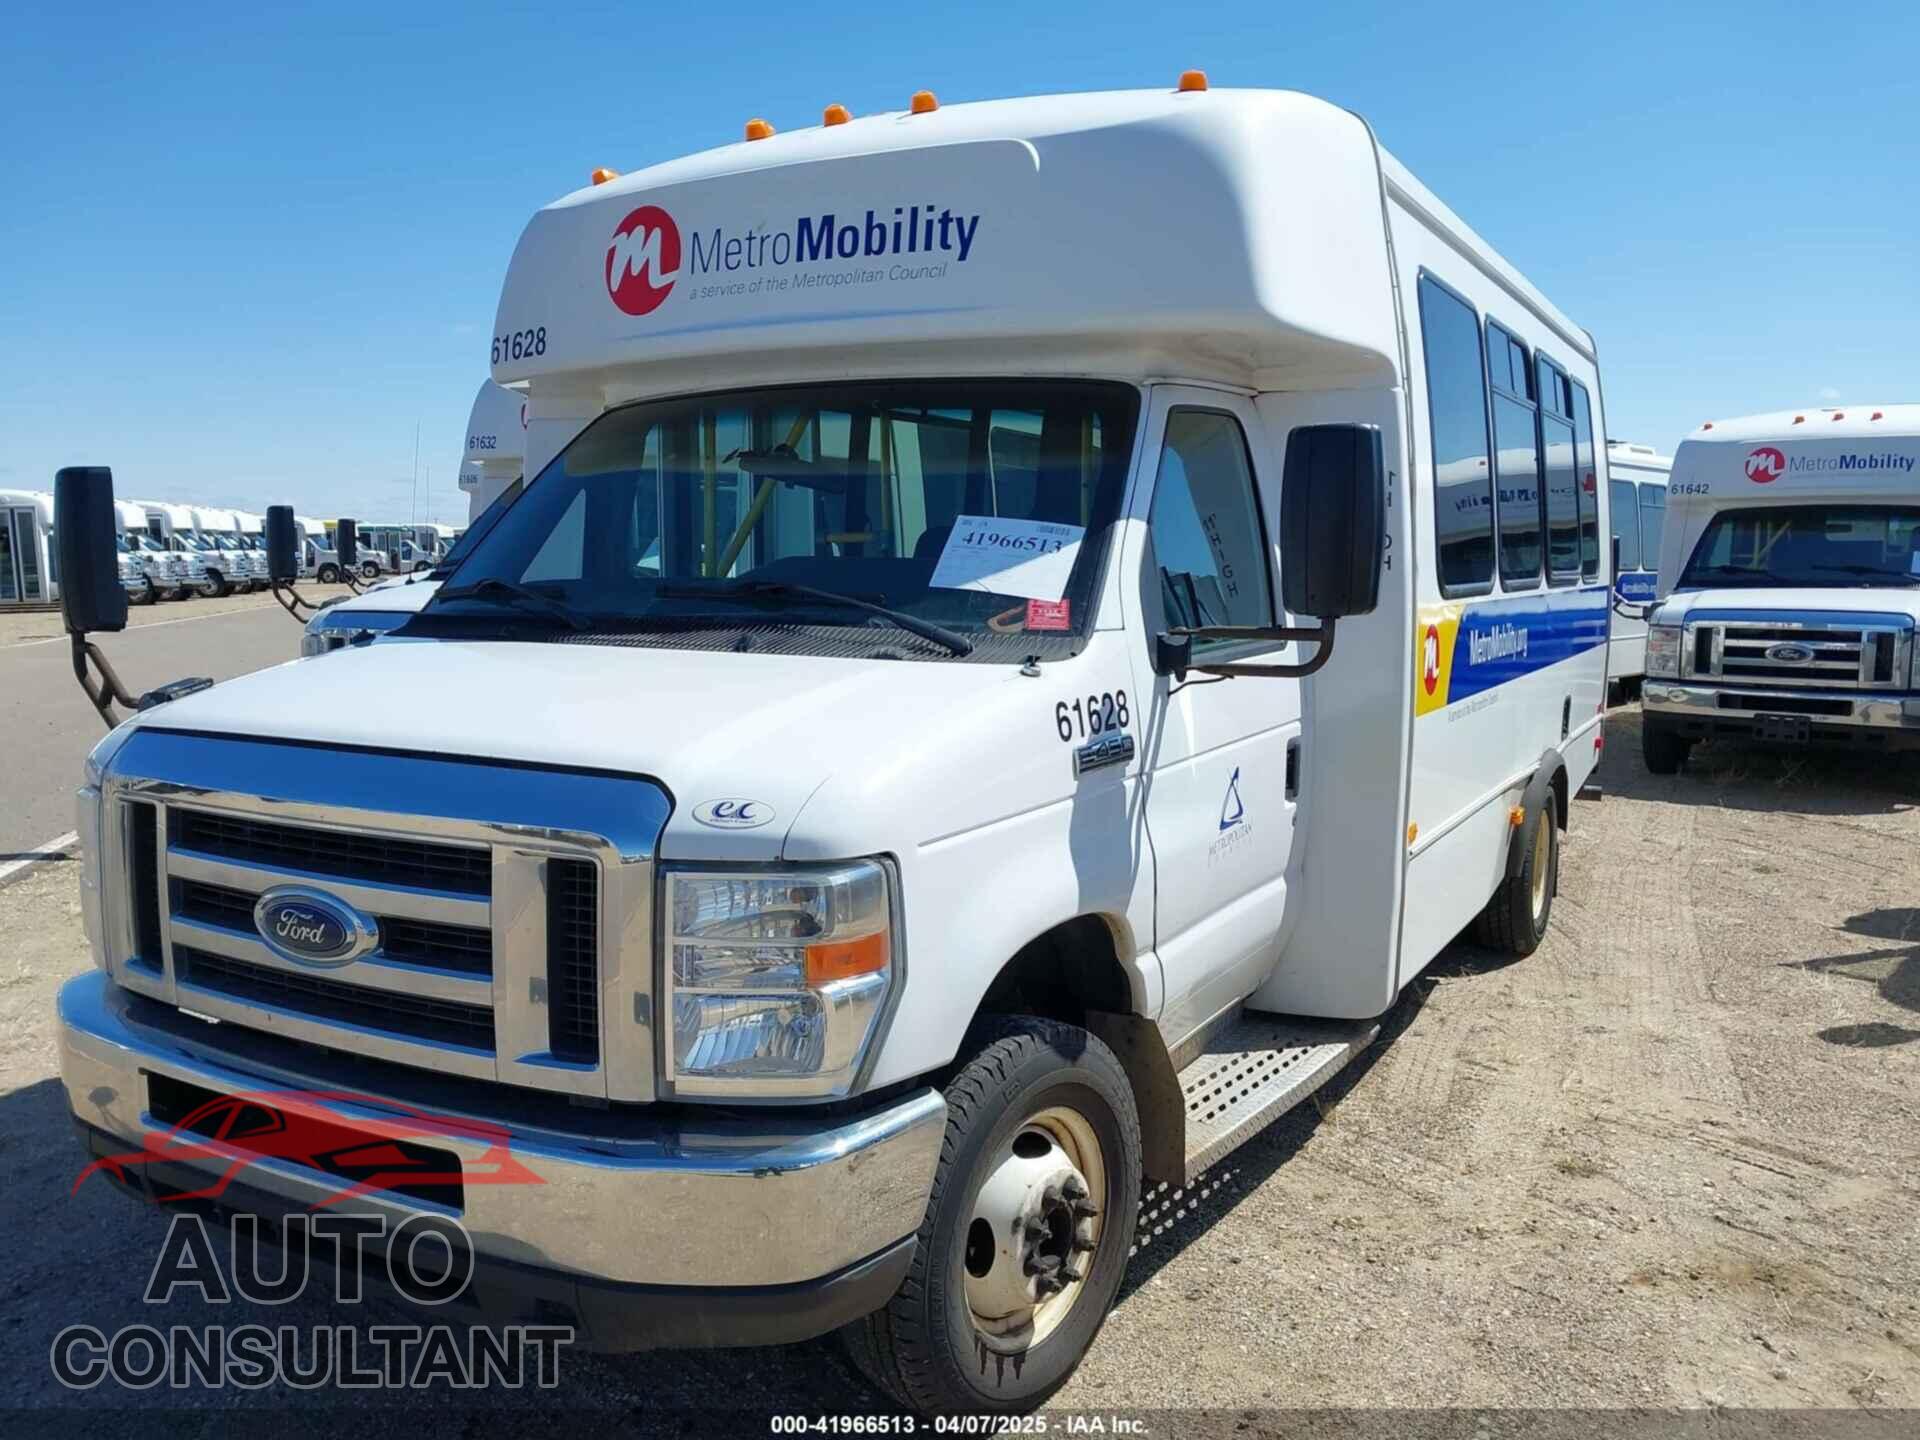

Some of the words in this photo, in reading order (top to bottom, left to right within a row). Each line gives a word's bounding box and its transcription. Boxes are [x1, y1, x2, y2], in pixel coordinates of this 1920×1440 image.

[691, 205, 980, 275] MetroMobility
[689, 288, 698, 300] a
[701, 281, 745, 299] service
[749, 277, 763, 296] of
[765, 275, 788, 291] the
[792, 268, 884, 289] Metropolitan
[888, 262, 949, 281] Council
[491, 327, 546, 364] 61628
[470, 436, 496, 449] 61632
[1789, 454, 1915, 473] MetroMobility
[1670, 483, 1710, 495] 61642
[962, 532, 1063, 553] 41966513
[1055, 689, 1130, 742] 61628
[275, 908, 326, 944] Ford
